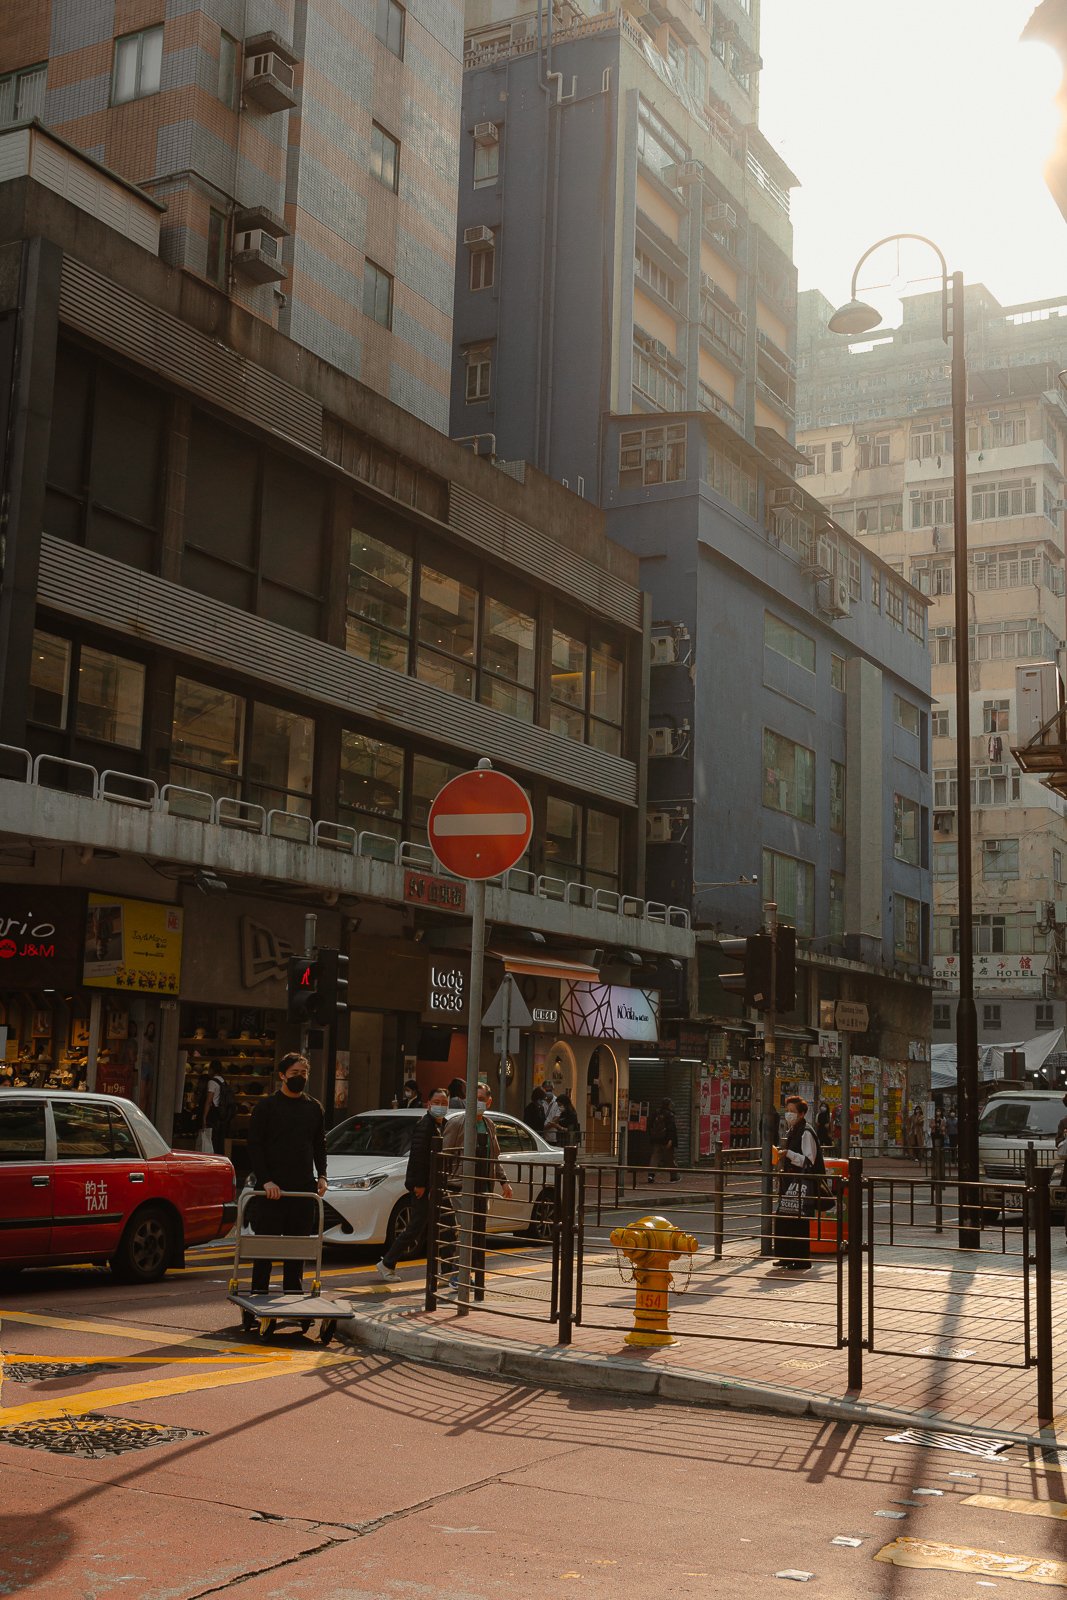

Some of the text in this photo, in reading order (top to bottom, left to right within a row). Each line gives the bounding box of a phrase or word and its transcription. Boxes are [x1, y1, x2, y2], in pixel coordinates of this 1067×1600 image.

[19, 944, 55, 957] J&M
[85, 1180, 108, 1195] 的士
[85, 1195, 108, 1211] TAXI
